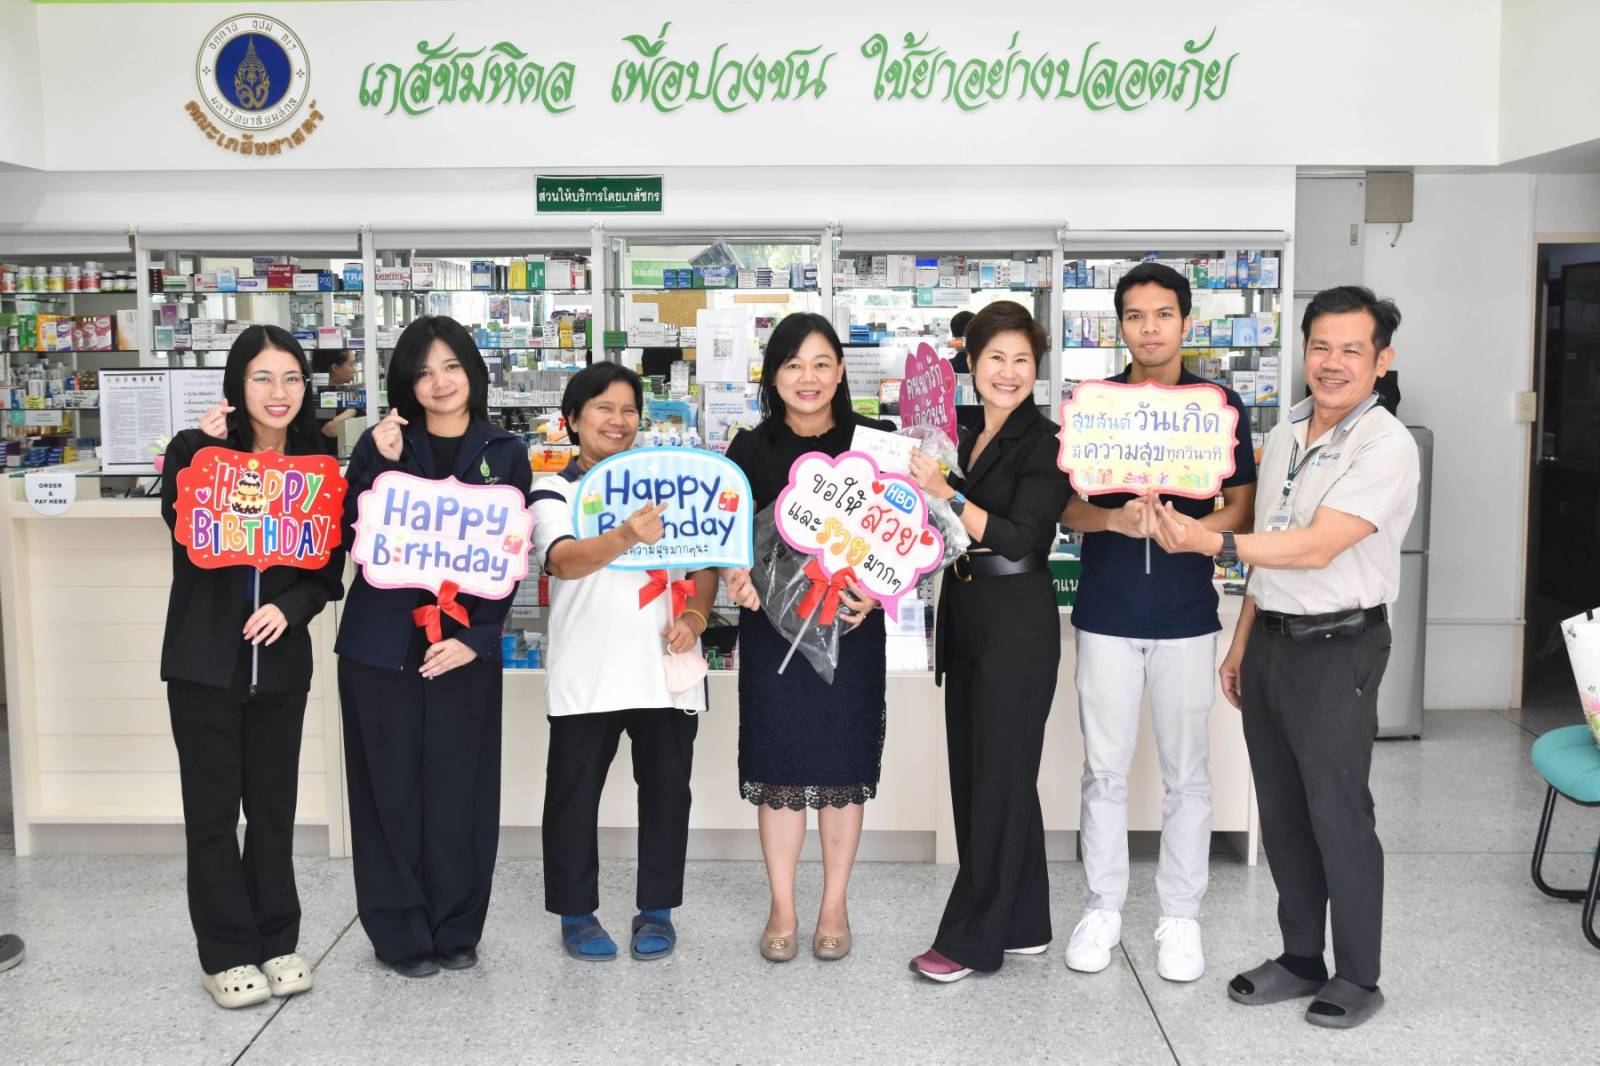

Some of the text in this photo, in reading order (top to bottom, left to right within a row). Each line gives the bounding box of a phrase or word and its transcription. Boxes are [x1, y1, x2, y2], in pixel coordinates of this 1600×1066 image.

[358, 21, 1240, 116] เภสัชมหิดล เพื่อปวงชน ใช้ยาอย่างปลอดภัย
[184, 99, 325, 157] คณะเภสัชศาสตร์
[538, 186, 660, 202] ส่วนให้บริการโดยเภสัชกร
[213, 462, 325, 514] HPPY
[605, 469, 721, 513] Happy
[887, 484, 917, 511] HBD
[192, 507, 331, 561] BIRTHDAY
[383, 487, 509, 541] Happy
[598, 505, 735, 546] Bhday
[624, 543, 709, 559] ความสุขมากๆนะ
